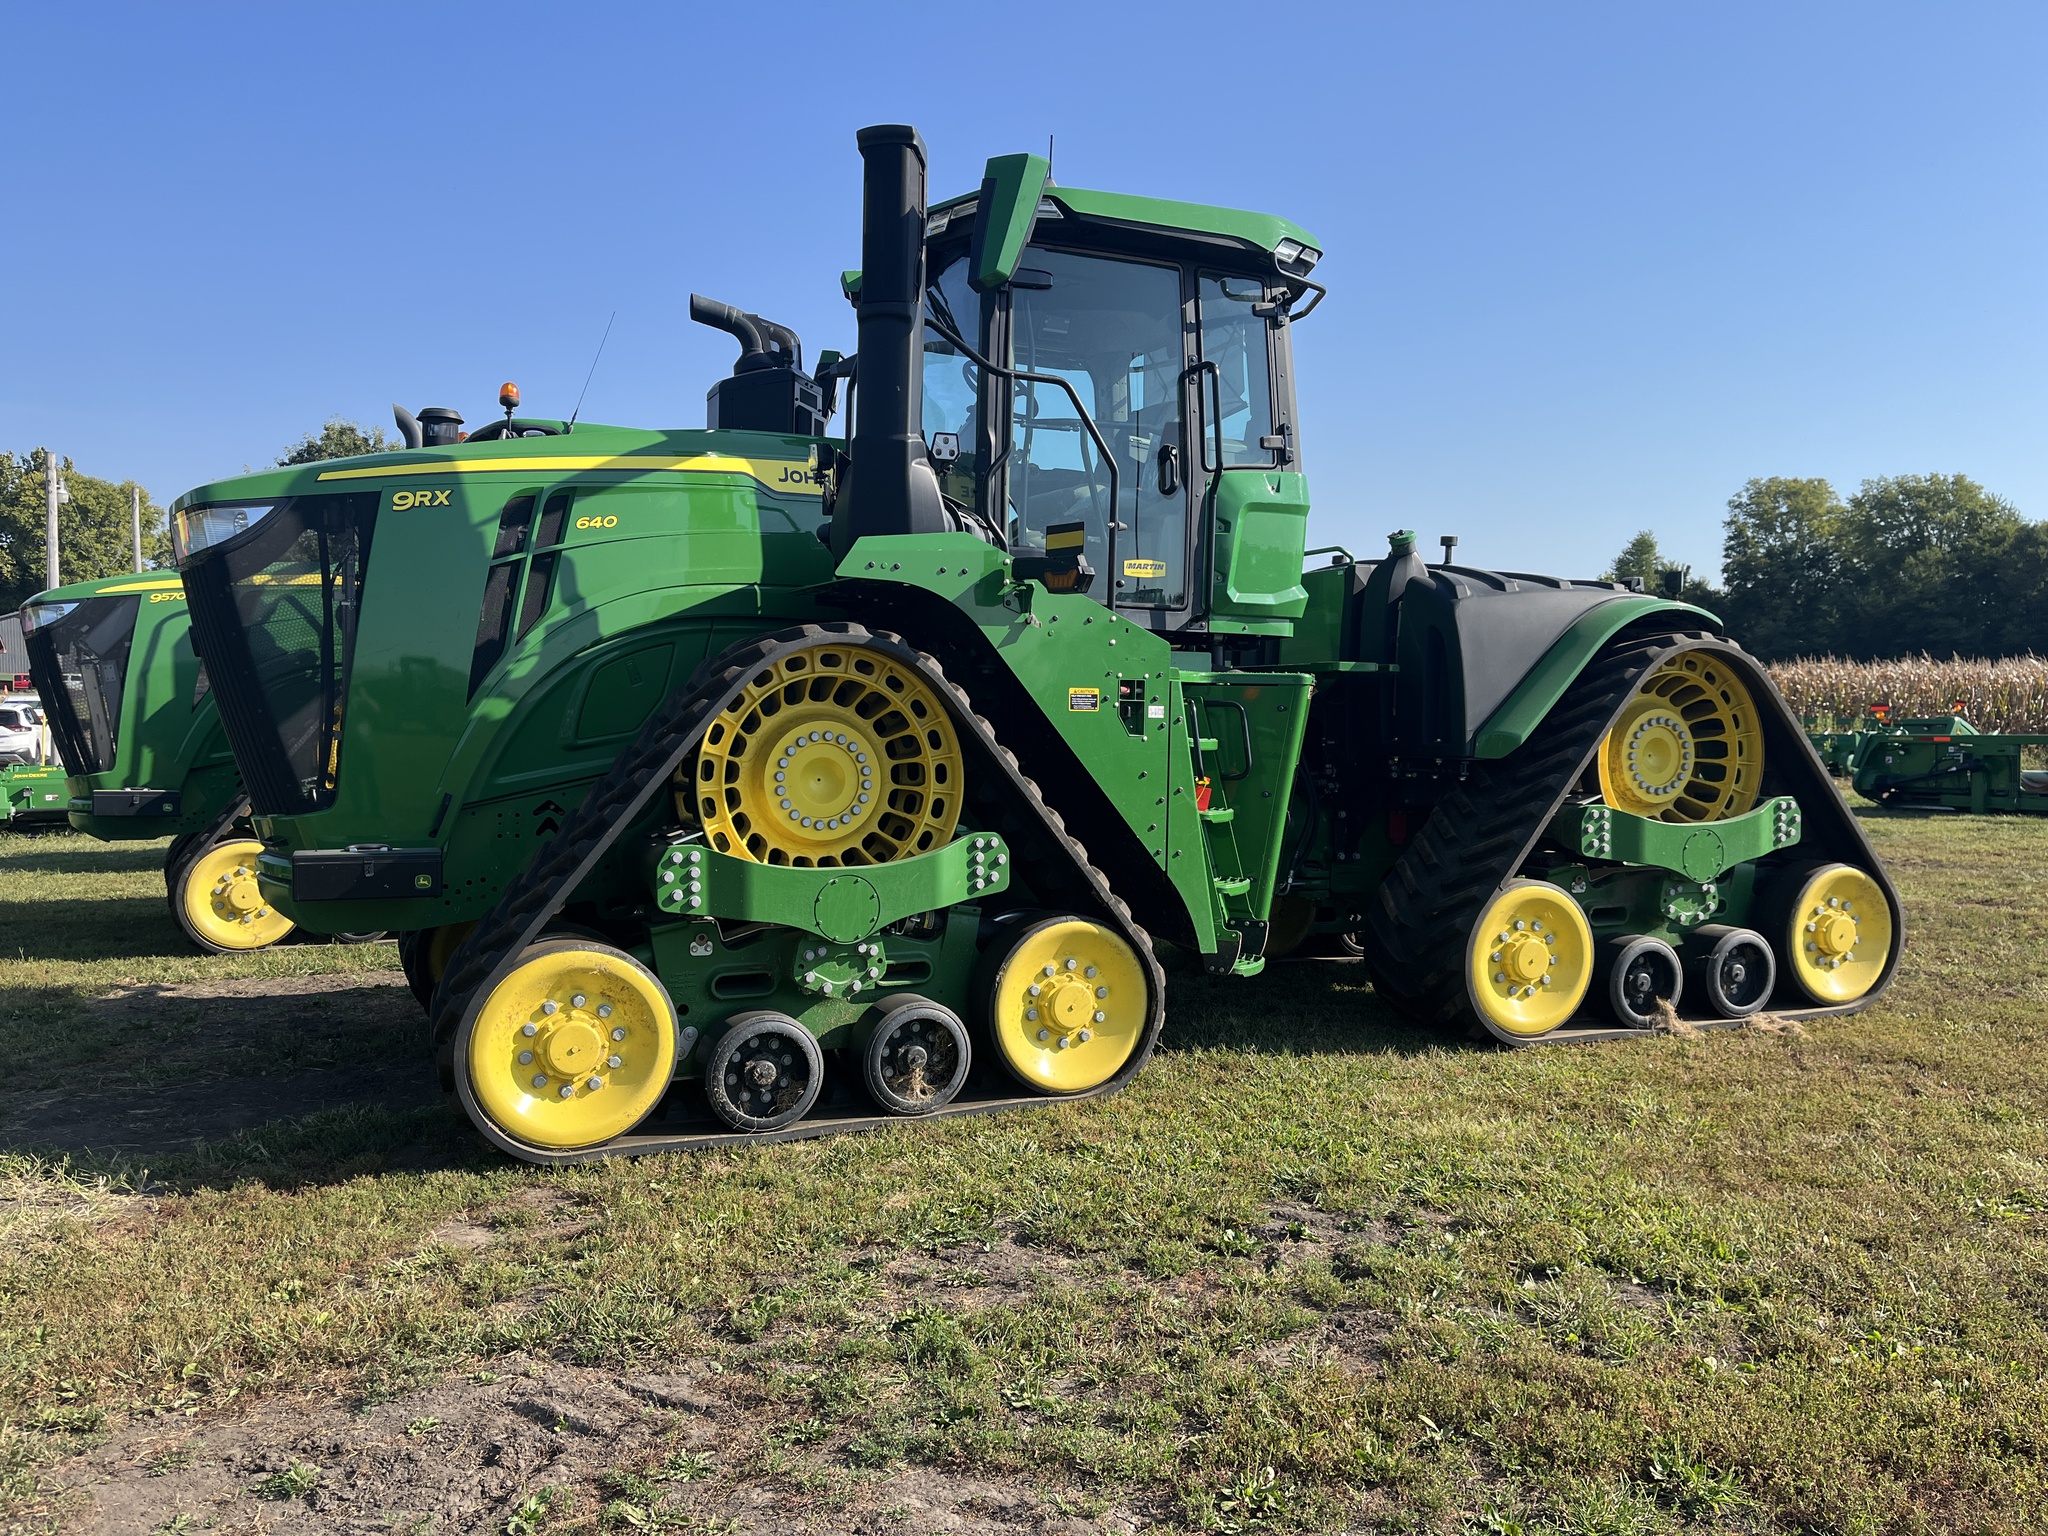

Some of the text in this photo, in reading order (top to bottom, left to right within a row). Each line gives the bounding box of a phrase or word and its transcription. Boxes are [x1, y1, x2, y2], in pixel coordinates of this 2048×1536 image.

[778, 467, 817, 484] JOH
[392, 490, 453, 511] 9RX
[575, 515, 619, 530] 640
[1127, 562, 1165, 571] MARTIN
[150, 592, 186, 604] 9570
